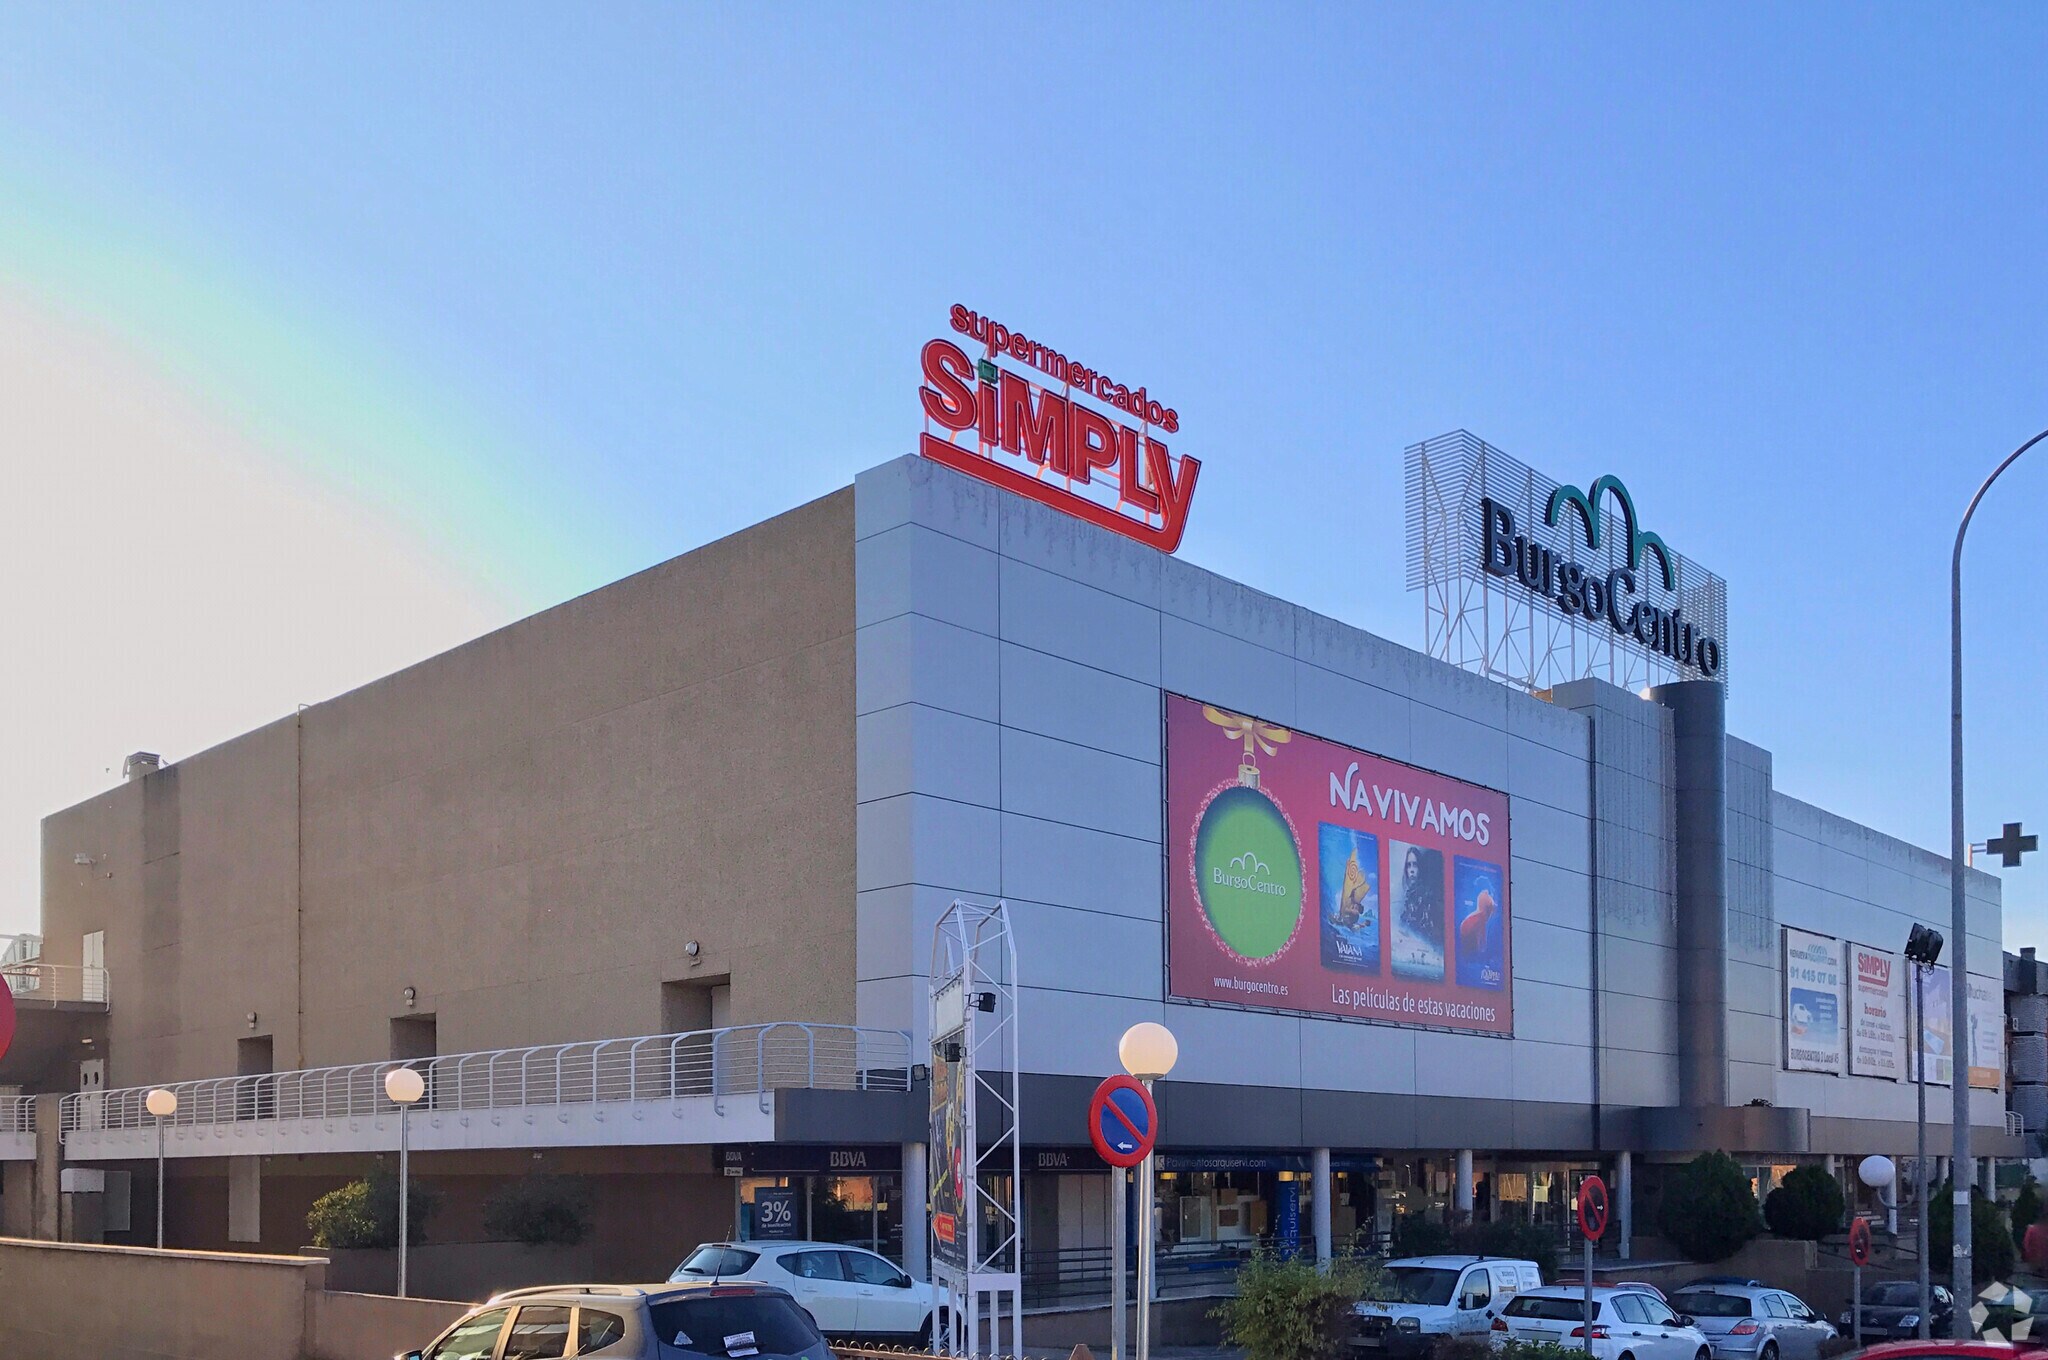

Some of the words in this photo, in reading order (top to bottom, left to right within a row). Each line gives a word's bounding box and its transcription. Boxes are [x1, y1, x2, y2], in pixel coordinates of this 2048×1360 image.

[950, 303, 1179, 434] supermercados
[1482, 497, 1721, 676] BurgoCentro
[1213, 866, 1287, 897] BurgoCentro
[1213, 976, 1289, 996] www.burgocentro.es
[1331, 984, 1351, 1006] Las
[1353, 987, 1400, 1012] películas
[1402, 992, 1416, 1013] de
[1418, 997, 1443, 1016] estas
[1444, 1001, 1496, 1022] vacaciones
[1864, 1002, 1887, 1018] horario
[725, 1151, 742, 1161] BBVA
[829, 1151, 867, 1168] BBVA
[1038, 1152, 1068, 1167] BBVA
[761, 1200, 792, 1223] 3%
[1288, 1187, 1298, 1251] rquiservi
